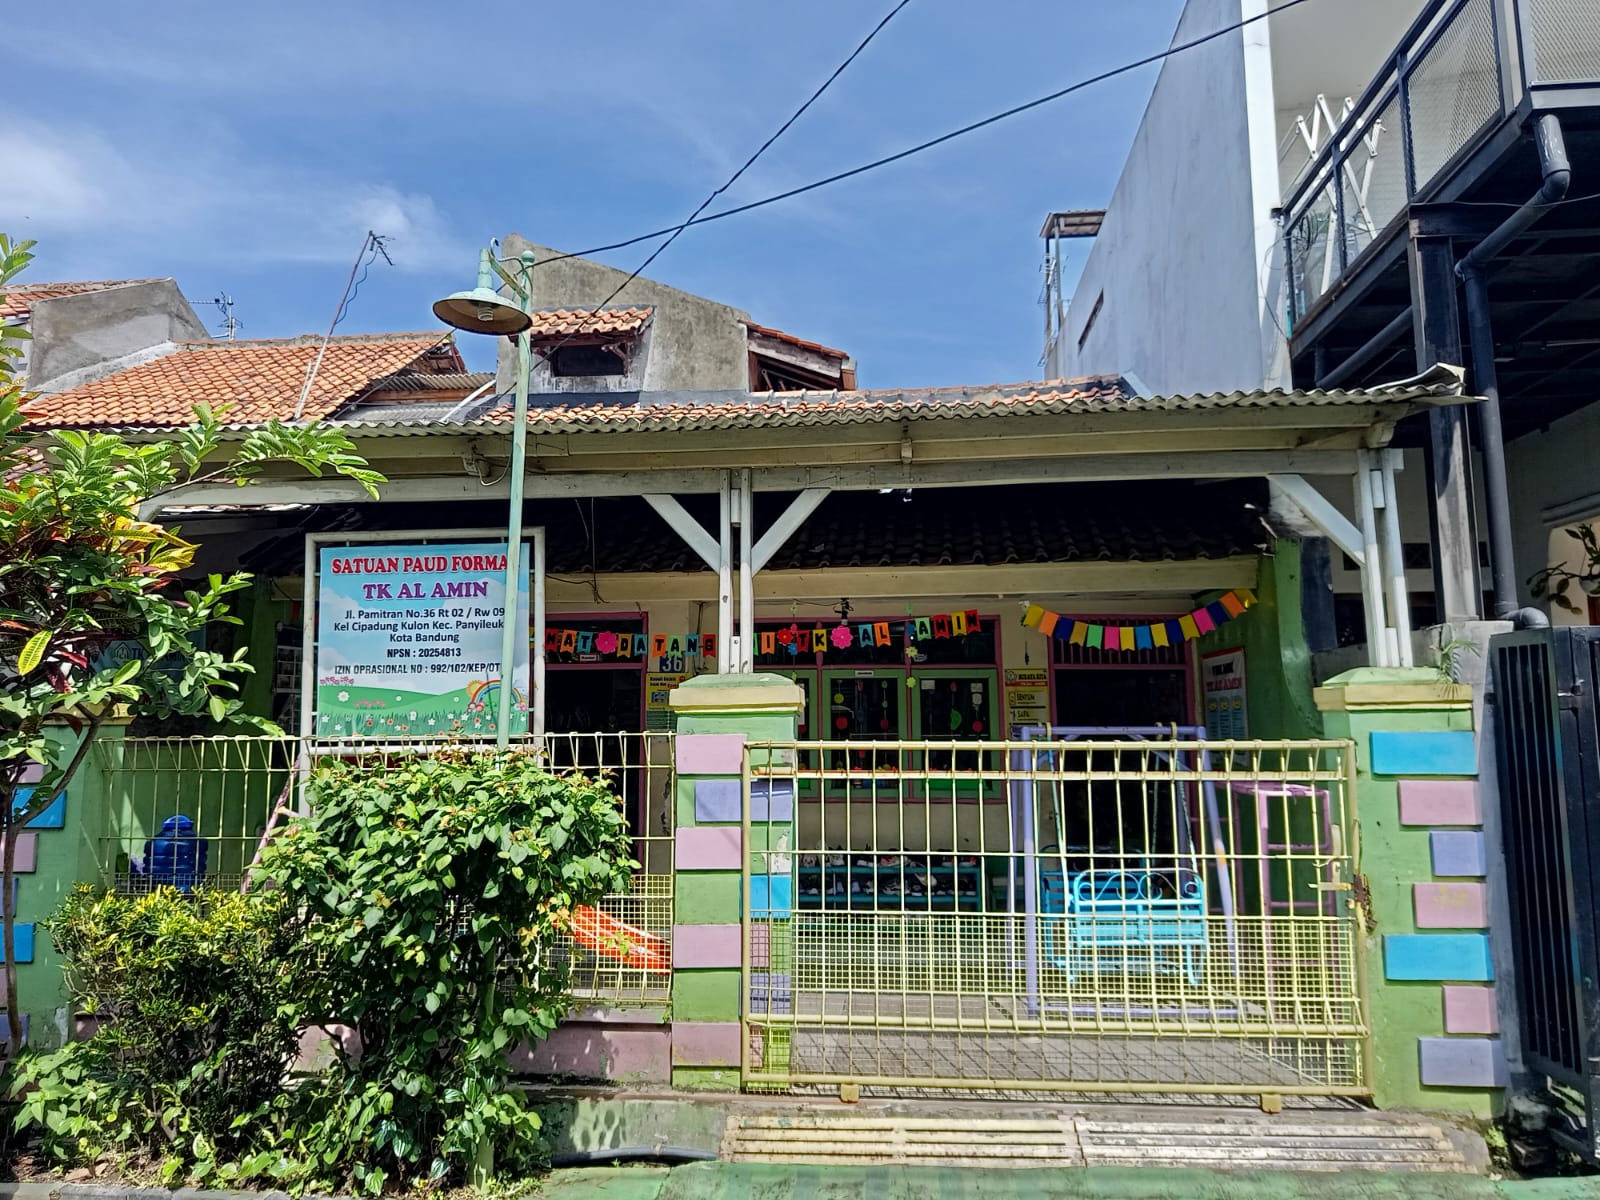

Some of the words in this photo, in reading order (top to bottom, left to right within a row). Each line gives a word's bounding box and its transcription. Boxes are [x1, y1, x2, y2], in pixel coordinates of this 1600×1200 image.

[332, 557, 399, 574] SATUAN
[403, 556, 448, 573] PAUD
[452, 555, 508, 571] FORMA
[362, 583, 392, 600] TK
[397, 582, 426, 599] AL
[430, 581, 489, 598] AMIN
[344, 609, 356, 620] Jl.
[358, 609, 403, 619] Pamitran
[405, 608, 436, 618] No.36
[438, 608, 450, 618] Rt
[451, 608, 464, 618] 02
[465, 606, 473, 619] /
[474, 607, 491, 617] Rw
[492, 607, 505, 617] 09
[333, 621, 349, 631] Kel
[351, 621, 399, 633] Cipadung
[400, 620, 430, 630] Kulon
[432, 620, 453, 630] Kec.
[455, 618, 505, 631] Panyileuk
[620, 637, 714, 653] DATANG
[798, 631, 826, 649] TK
[860, 625, 889, 643] AL
[918, 611, 981, 635] AMIN
[389, 633, 413, 643] Kota
[415, 632, 460, 643] Bandung
[386, 648, 411, 658] NPSN
[418, 647, 462, 658] 20254813
[334, 664, 351, 675] IZIN
[353, 664, 408, 674] OPRASIONAL
[410, 663, 423, 674] NO
[430, 662, 501, 674] 992/102/KEP/OT
[662, 654, 683, 672] 36
